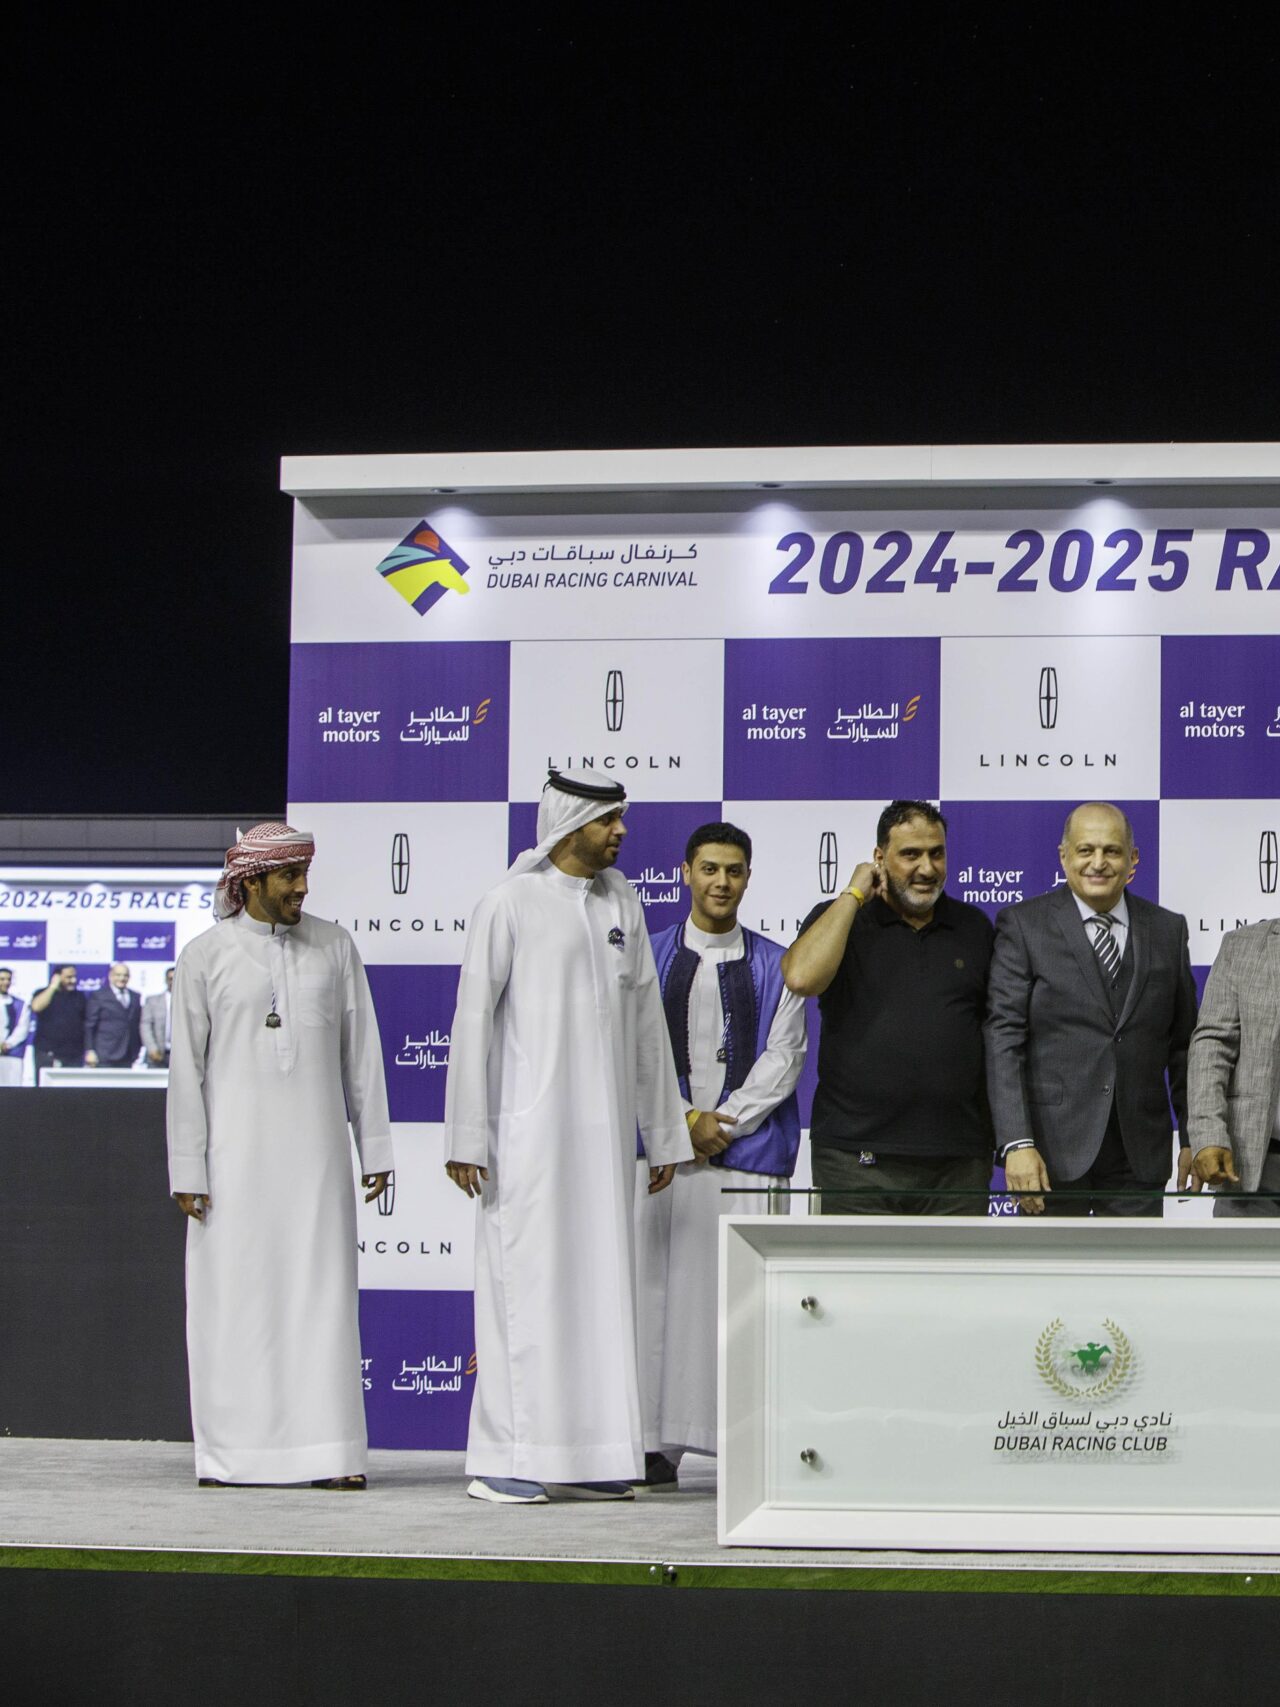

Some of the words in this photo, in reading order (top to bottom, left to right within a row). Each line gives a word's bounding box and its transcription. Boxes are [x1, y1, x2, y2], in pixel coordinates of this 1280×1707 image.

[488, 549, 527, 570] دبي
[532, 545, 615, 565] سباقات
[620, 543, 698, 565] كرنفال
[767, 528, 1194, 595] 2024-2025
[486, 573, 540, 589] DUBAI
[543, 572, 608, 588] RACING
[613, 571, 699, 587] CARNIVAL
[318, 707, 332, 723] al
[337, 708, 381, 727] tayer
[742, 703, 757, 720] al
[762, 705, 807, 724] tayer
[1179, 702, 1194, 718] al
[1199, 703, 1246, 722] tayer
[323, 728, 381, 743] motors
[399, 725, 470, 746] للسيارات
[747, 724, 807, 740] motors
[826, 722, 899, 743] للسيارات
[1184, 722, 1245, 738] motors
[547, 756, 681, 769] LINCOLN
[979, 753, 1117, 767] LINCOLN
[958, 866, 973, 883] al
[978, 868, 1024, 887] tayer
[0, 891, 121, 909] 2024-2025
[129, 892, 190, 909] RACE
[963, 888, 1024, 903] motors
[391, 1374, 462, 1395] للسيارات
[997, 1410, 1039, 1430] الخيل
[1041, 1410, 1092, 1431] لسباق
[1095, 1416, 1129, 1434] دبي
[1133, 1411, 1173, 1432] نادي
[993, 1436, 1048, 1451] DUBAI
[1051, 1436, 1117, 1451] RACING
[1121, 1436, 1168, 1451] CLUB
